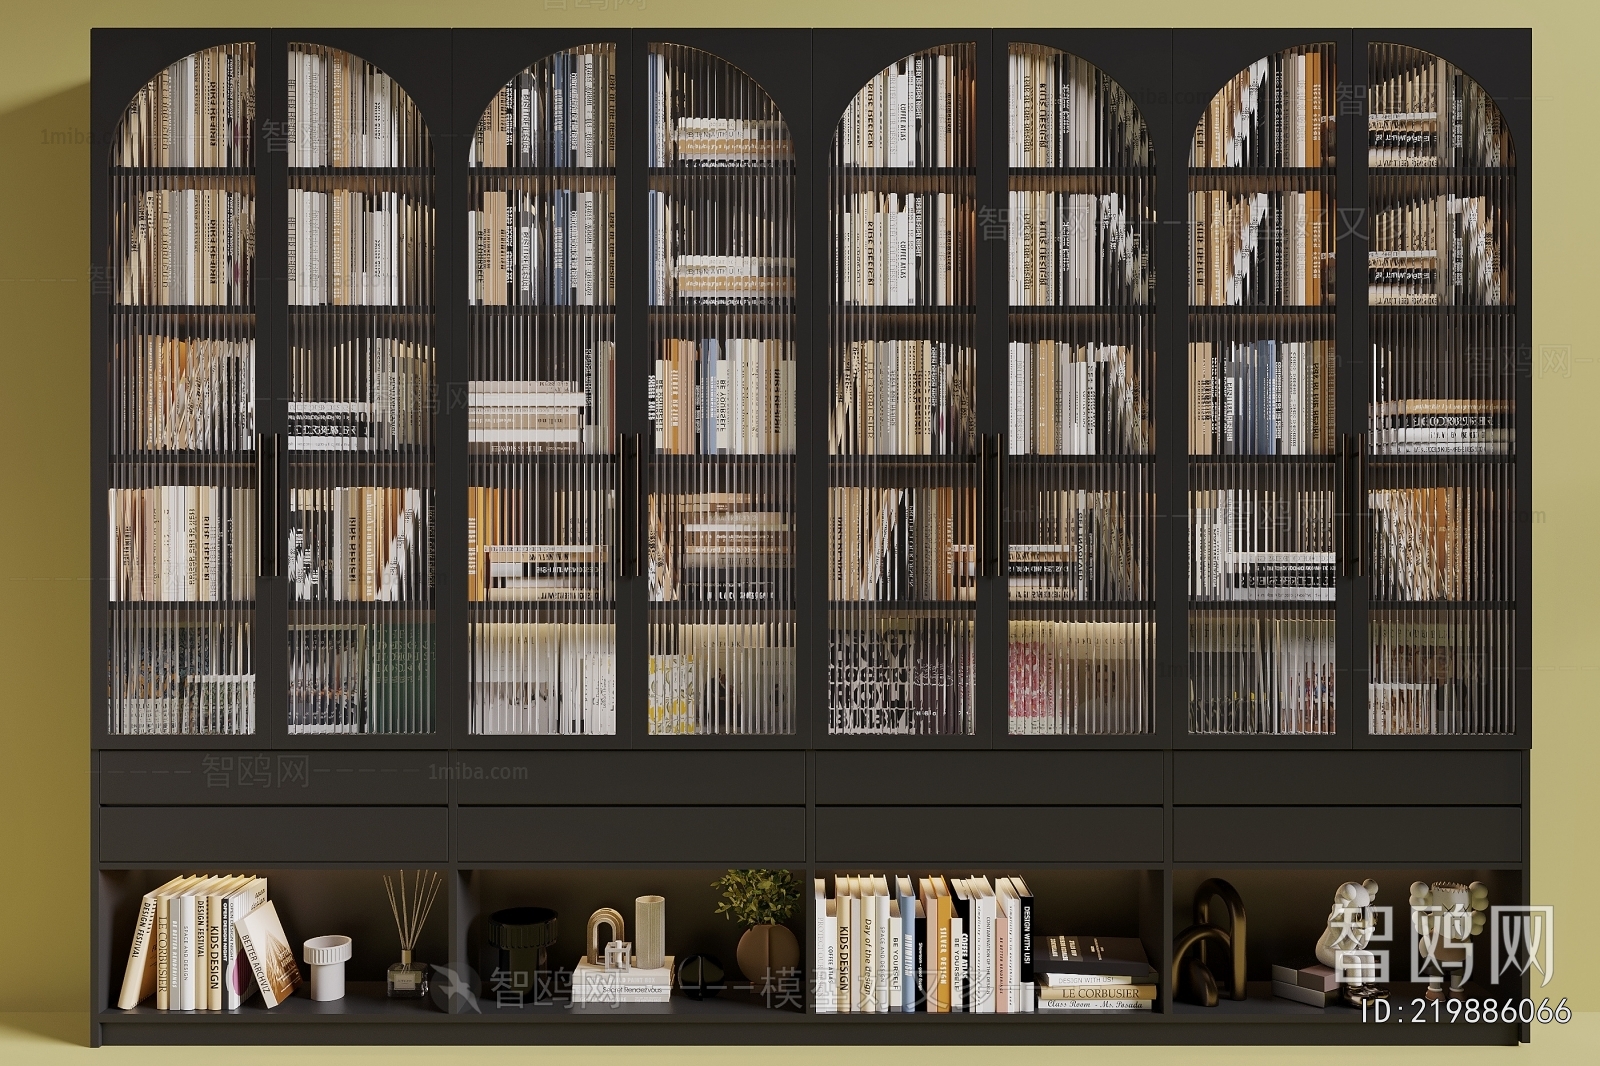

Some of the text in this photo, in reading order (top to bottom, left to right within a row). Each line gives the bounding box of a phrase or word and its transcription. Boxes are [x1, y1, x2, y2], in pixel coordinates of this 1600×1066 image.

[132, 902, 150, 958] DESIGN FESTIVAL
[865, 938, 872, 947] of
[893, 938, 898, 947] BE
[954, 938, 959, 947] BE
[159, 917, 167, 992] LE CORBUSIER
[210, 926, 219, 989] KIDS DESIGN
[242, 935, 270, 994] BETTER ARCHVIZ
[840, 926, 848, 991] KIDS DESIGN
[904, 934, 912, 976] MINIMALISM
[1047, 1000, 1066, 1008] Class
[1070, 1000, 1090, 1008] Room
[1062, 989, 1139, 999] LE CORBUSIER
